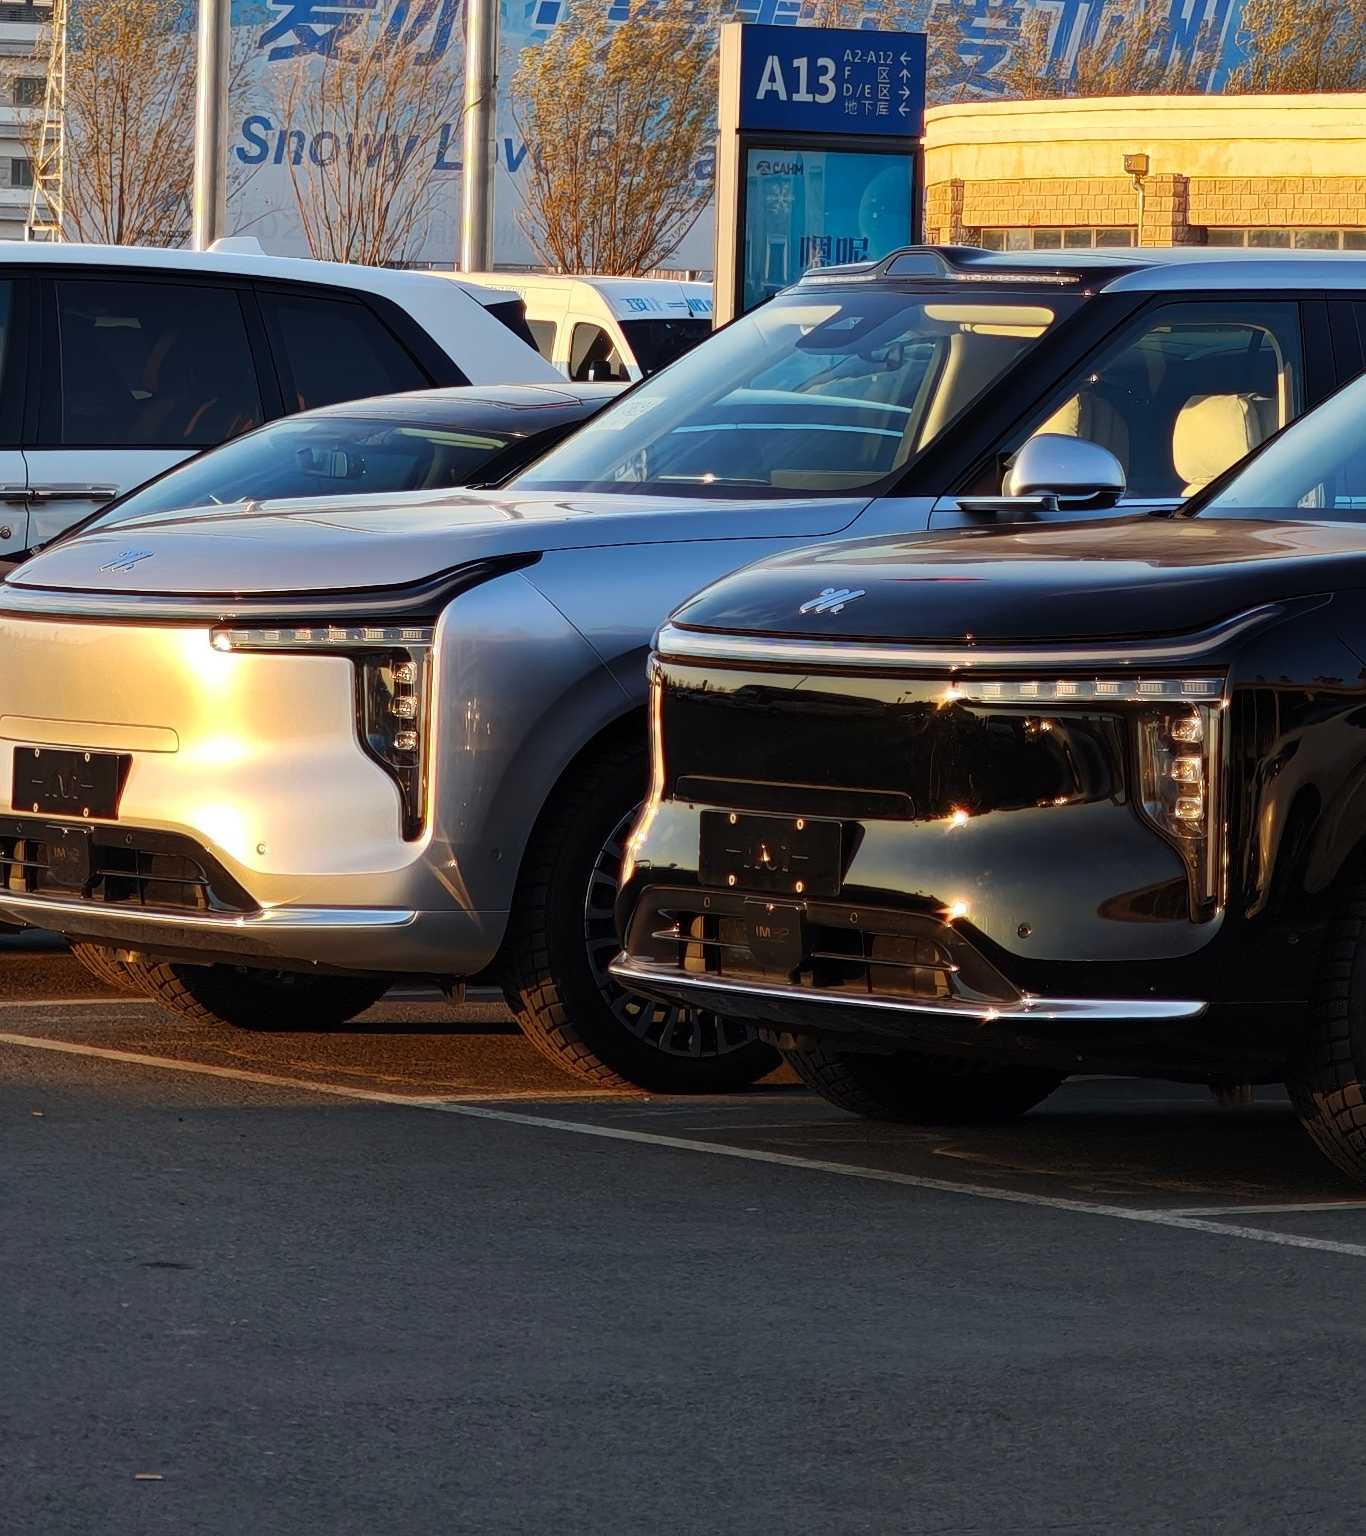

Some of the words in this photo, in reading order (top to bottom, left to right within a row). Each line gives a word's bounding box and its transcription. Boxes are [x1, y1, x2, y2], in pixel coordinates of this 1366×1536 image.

[843, 49, 893, 65] A2-A12
[755, 55, 837, 104] A13
[844, 66, 852, 80] F
[877, 66, 891, 83] 区
[843, 98, 890, 116] 地下库
